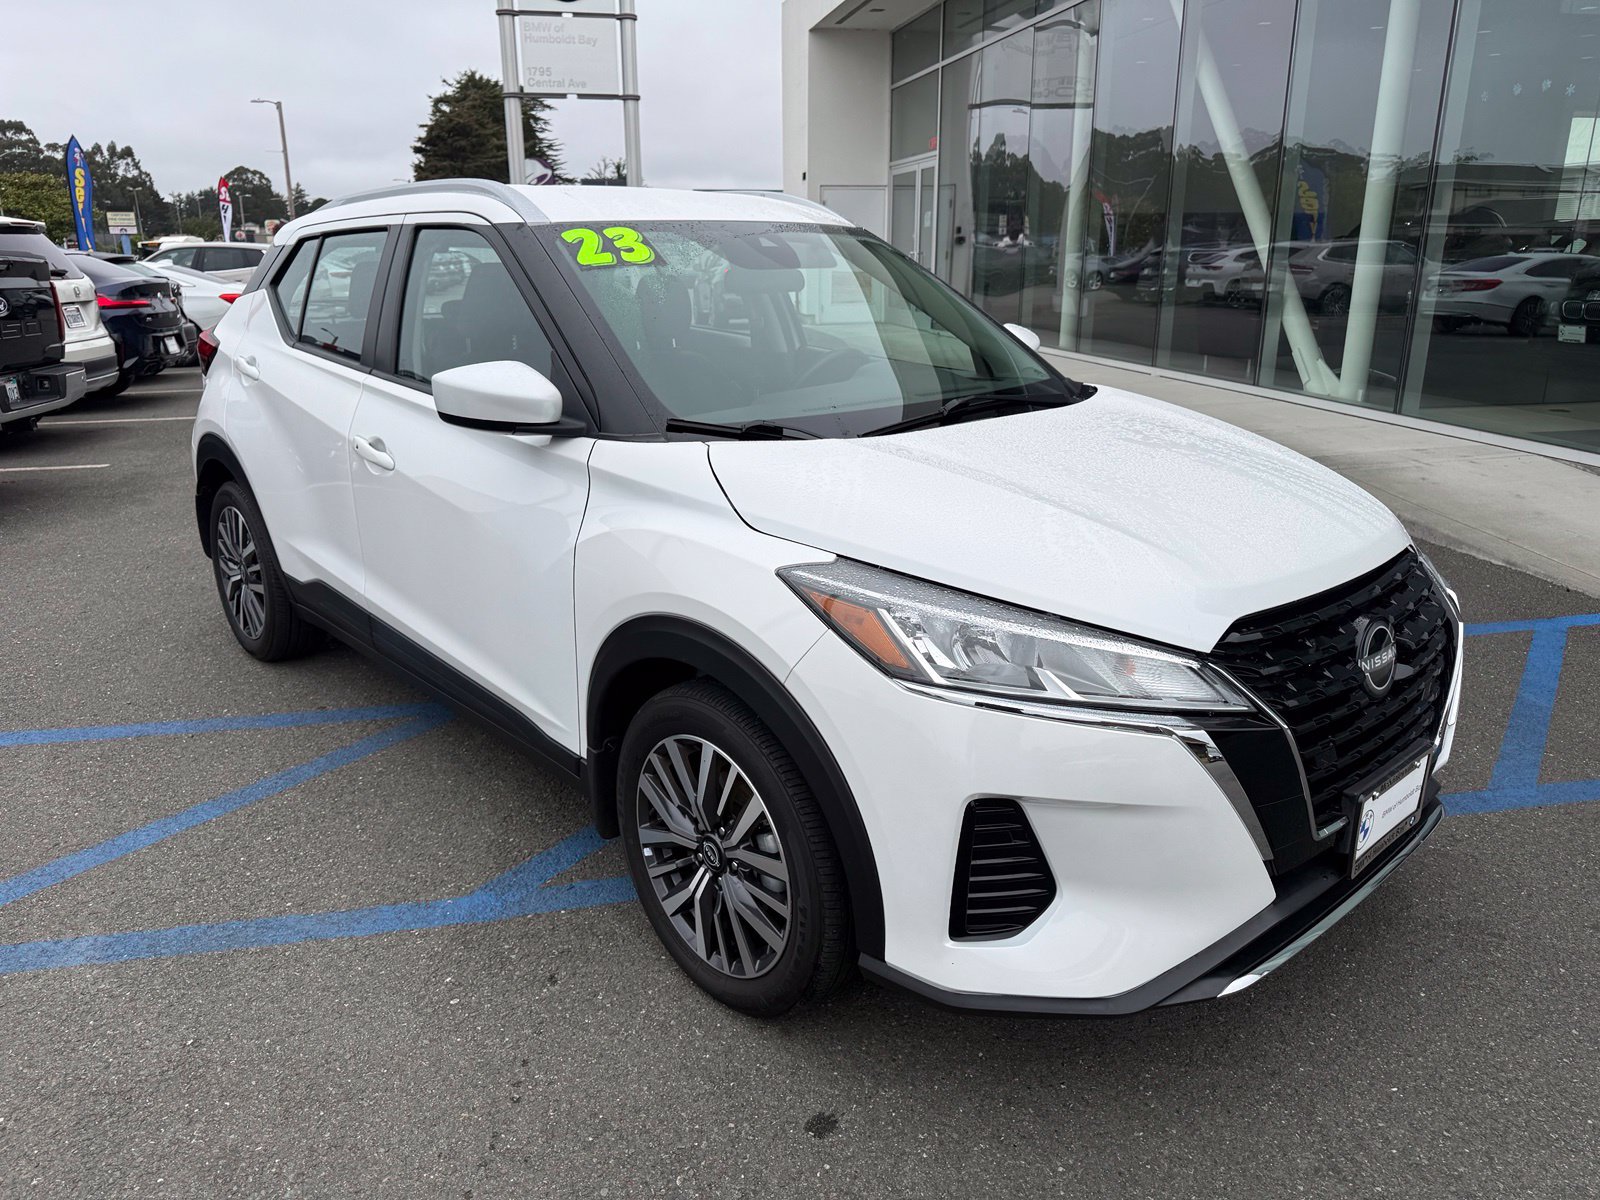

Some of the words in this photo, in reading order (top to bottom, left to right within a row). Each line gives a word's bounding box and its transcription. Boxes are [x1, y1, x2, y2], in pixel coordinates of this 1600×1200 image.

[523, 21, 552, 33] BMW
[554, 22, 566, 33] of
[524, 33, 577, 45] Humboldt
[578, 35, 598, 47] Bay
[526, 66, 553, 77] 1795
[527, 77, 566, 88] Central
[567, 78, 587, 88] Ave
[560, 226, 656, 267] 23
[1361, 645, 1397, 672] NISSAN
